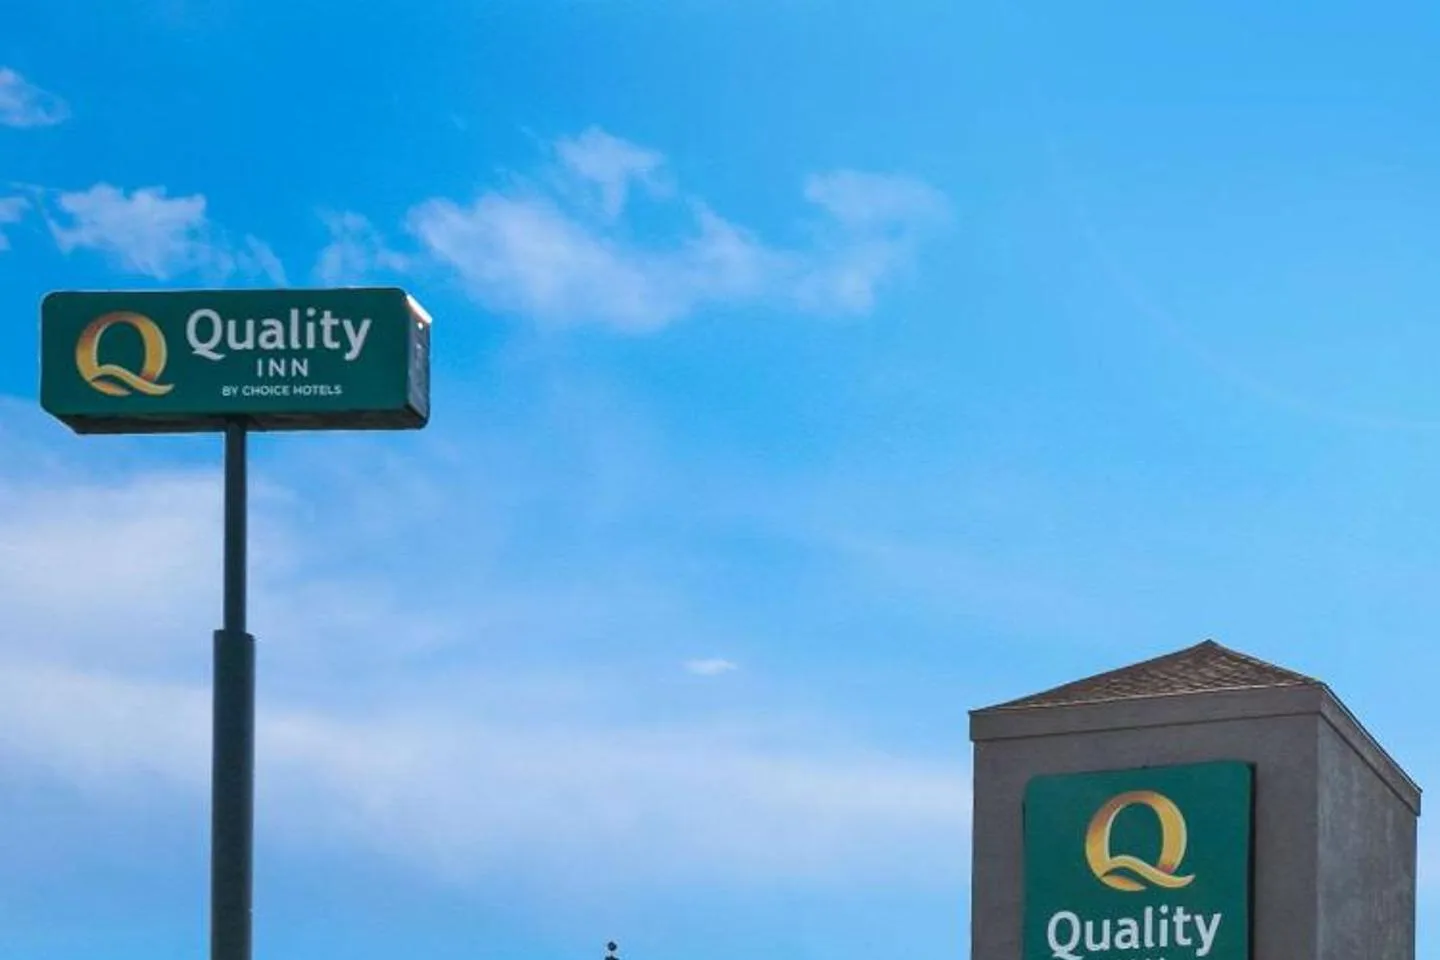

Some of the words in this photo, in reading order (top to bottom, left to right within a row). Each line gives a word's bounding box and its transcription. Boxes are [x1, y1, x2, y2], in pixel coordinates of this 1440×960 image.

[185, 307, 372, 361] Quality
[256, 358, 309, 377] INN
[222, 386, 239, 397] BY
[242, 385, 290, 396] CHOICE
[293, 384, 342, 395] HOTELS
